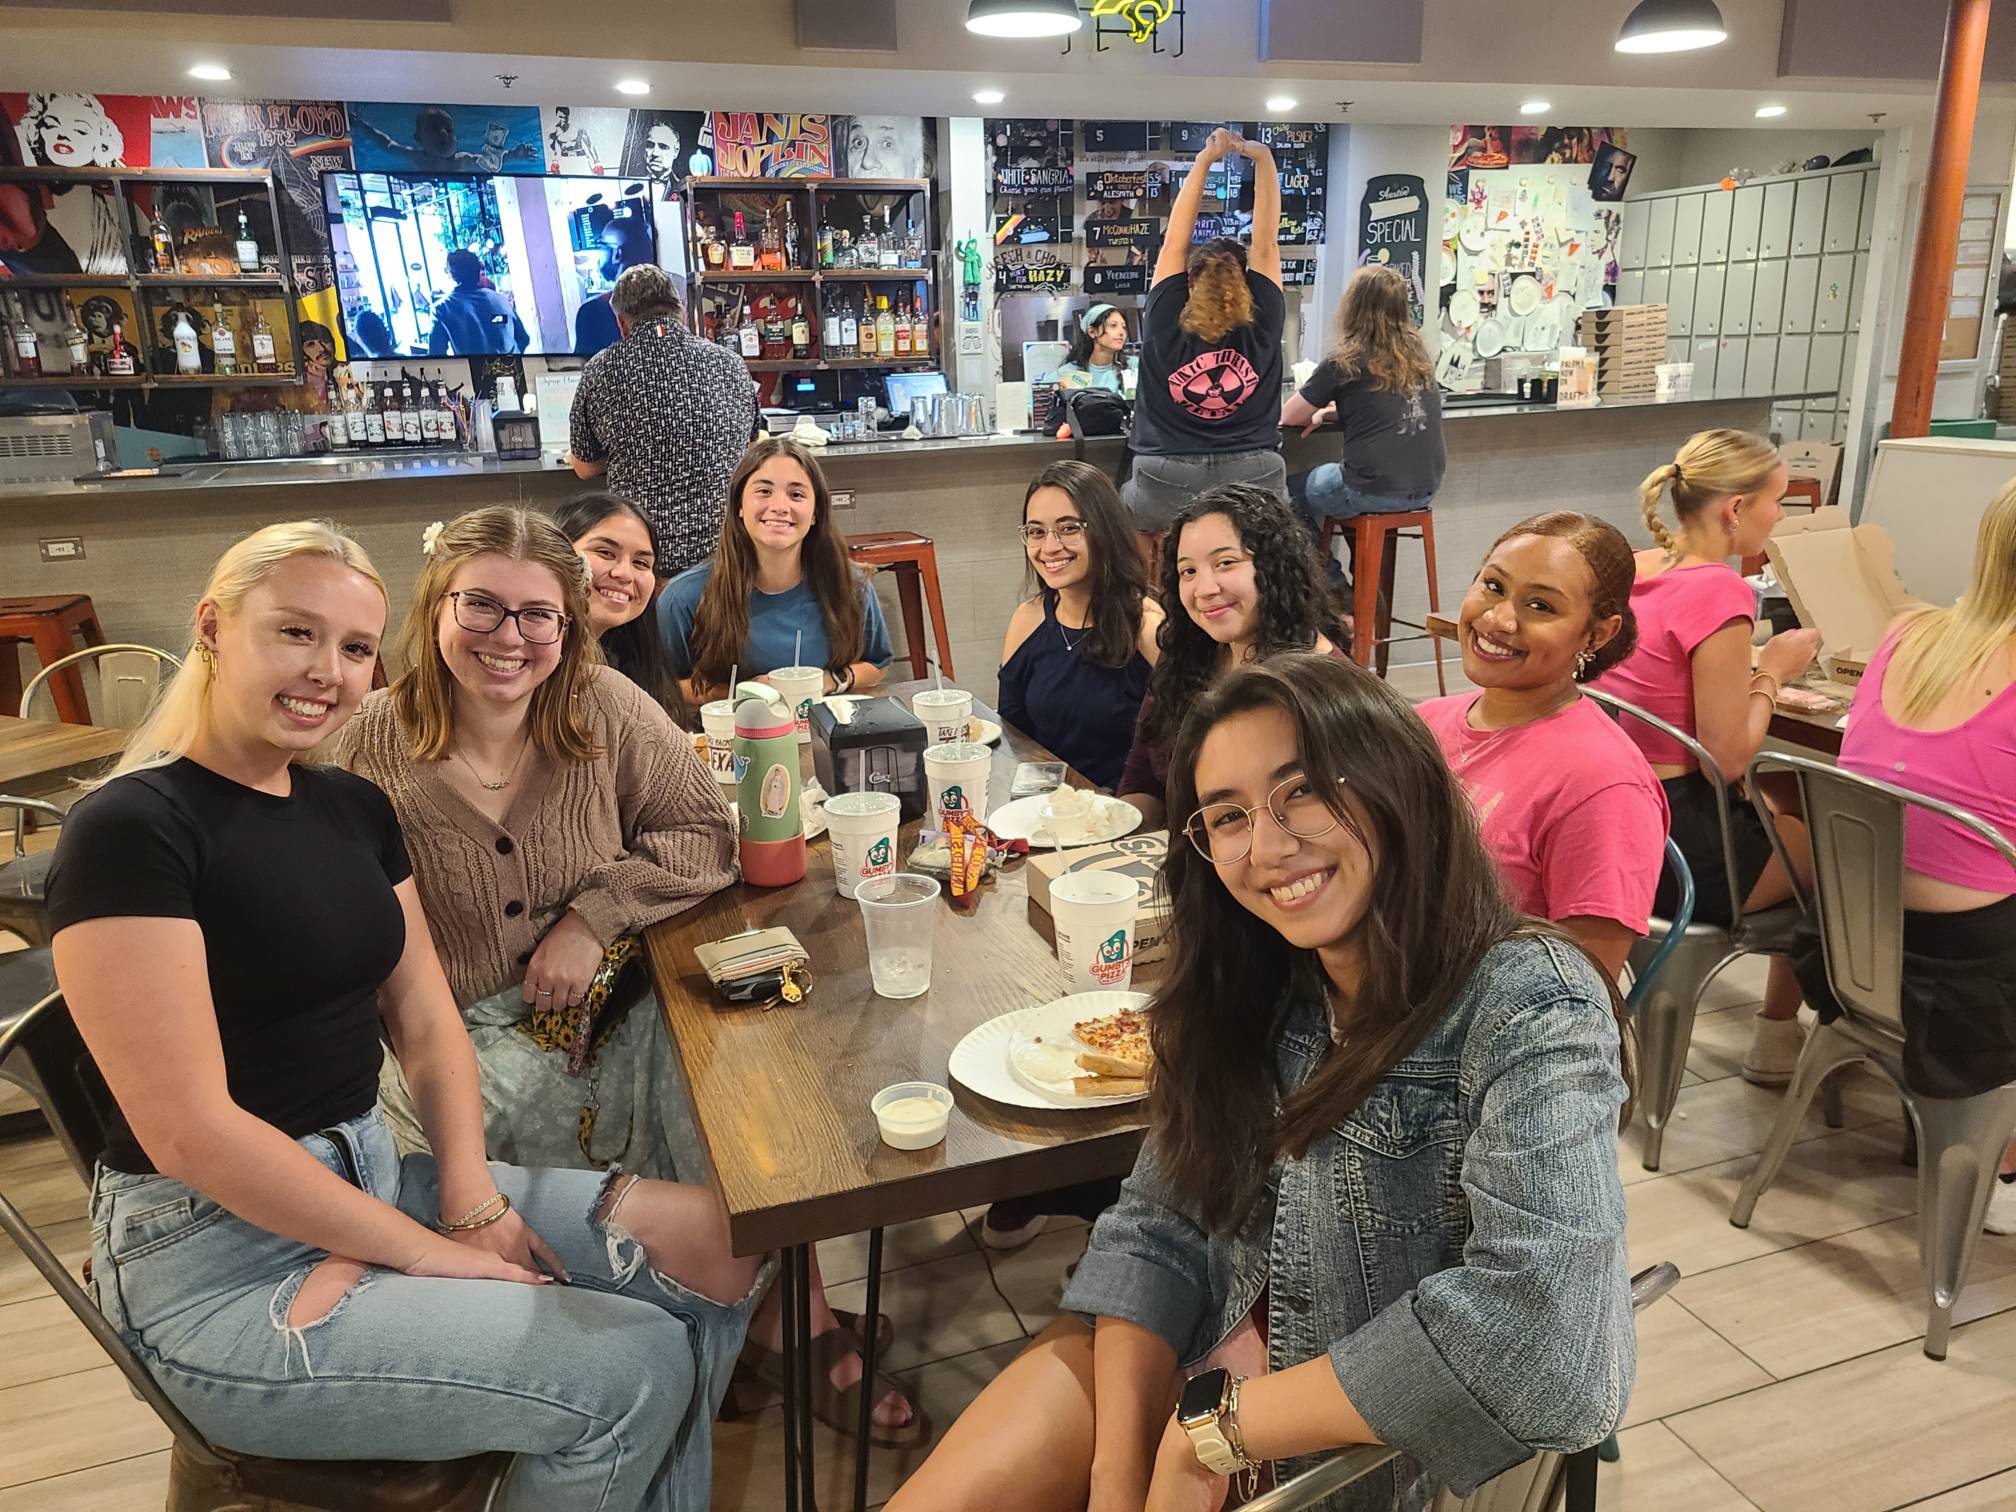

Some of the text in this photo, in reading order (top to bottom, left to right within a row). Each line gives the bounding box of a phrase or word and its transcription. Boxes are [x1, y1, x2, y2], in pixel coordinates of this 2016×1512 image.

[268, 104, 345, 139] FLOYD
[717, 112, 829, 145] JANIS
[259, 130, 297, 147] 1972
[1096, 129, 1105, 142] 5
[1181, 129, 1189, 141] 9
[1261, 127, 1272, 143] 13
[718, 141, 829, 178] JOPLIN
[1001, 168, 1069, 186] WHITE SANGRIA
[1284, 174, 1310, 189] LAGER
[1097, 180, 1105, 192] 6
[1378, 186, 1411, 200] Austin
[1092, 227, 1102, 241] 7
[1366, 217, 1422, 244] SPECIAL
[998, 271, 1007, 285] 4
[1028, 269, 1065, 282] HAZY
[711, 751, 735, 772] EXA
[1133, 935, 1161, 950] PEN
